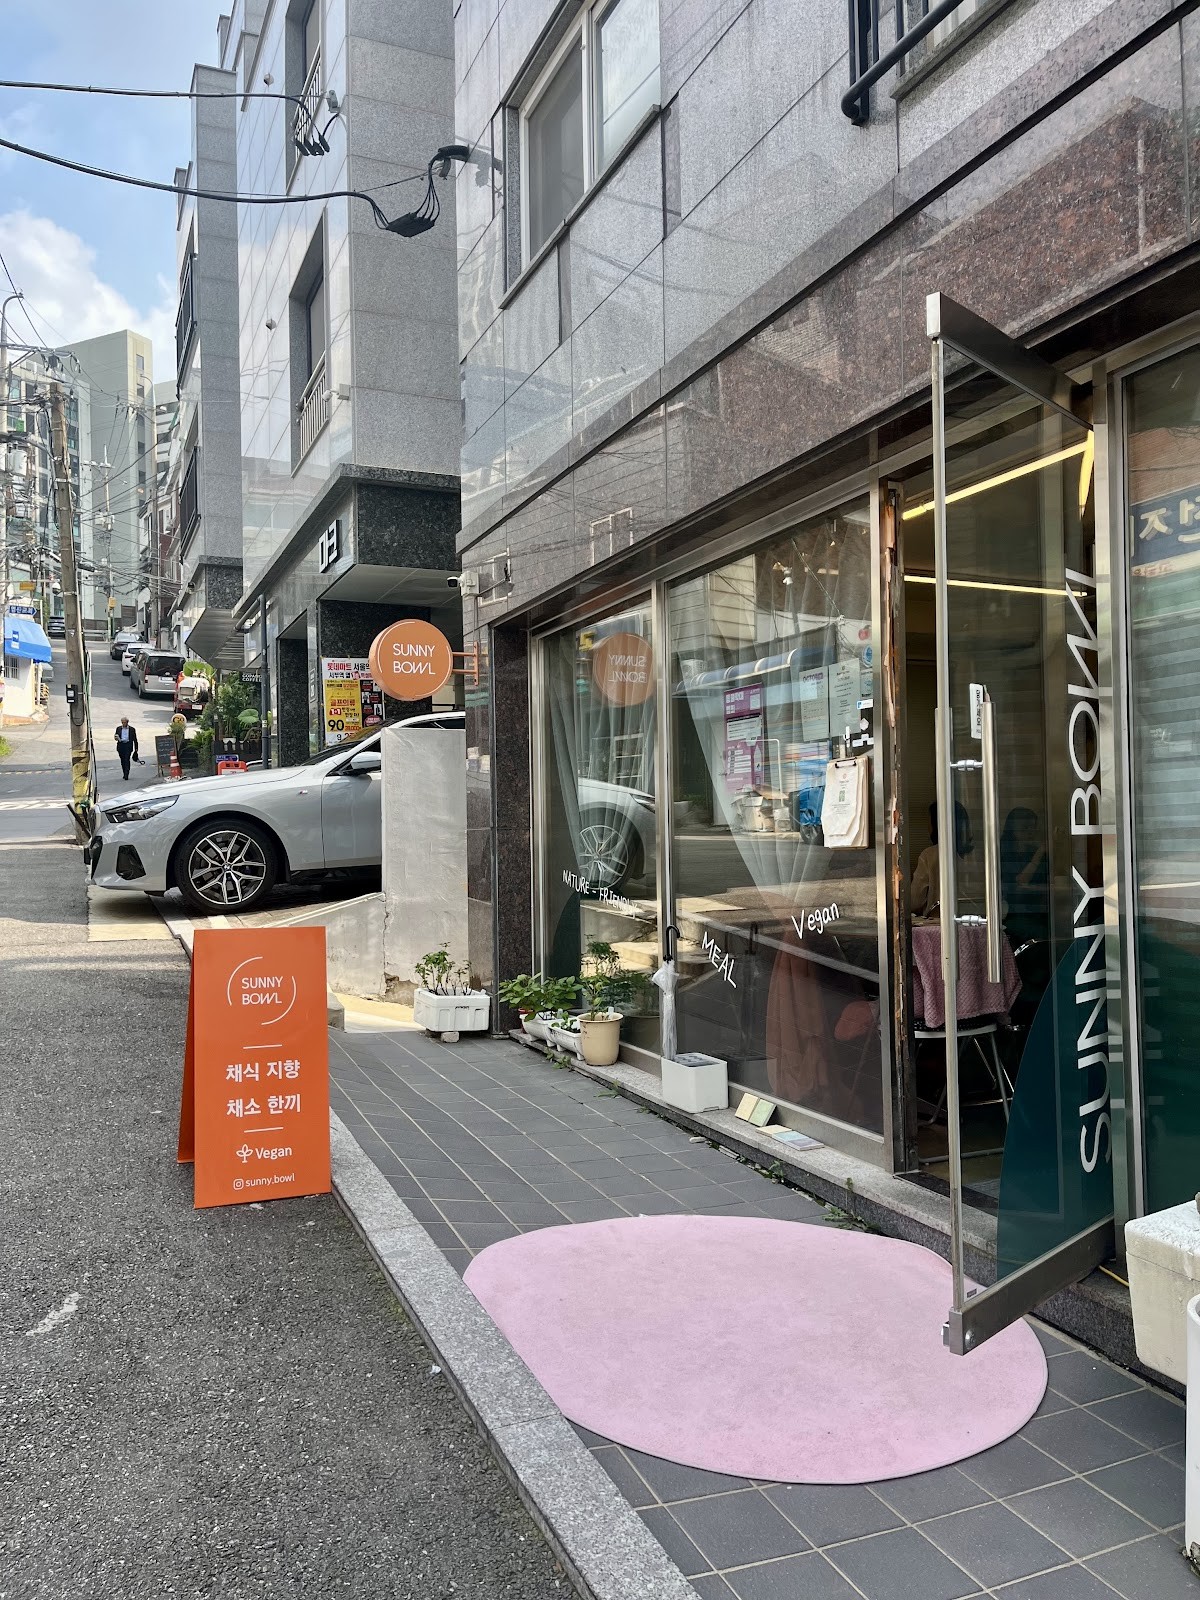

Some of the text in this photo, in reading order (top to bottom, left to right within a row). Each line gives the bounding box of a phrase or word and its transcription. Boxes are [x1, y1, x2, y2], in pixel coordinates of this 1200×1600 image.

[393, 643, 435, 657] SUNNY
[327, 662, 352, 671] 롯데마트
[393, 661, 436, 675] BOWL
[328, 719, 345, 731] 90
[562, 869, 590, 895] NATURE
[791, 902, 840, 939] Vegan
[701, 931, 737, 988] MEAL
[241, 976, 283, 989] SUNNY
[241, 993, 282, 1005] BOWL
[1071, 865, 1112, 1173] SUNNY
[225, 1059, 300, 1083] 채식 지향
[226, 1093, 301, 1118] 채소 한끼
[255, 1145, 292, 1160] Vegan
[245, 1172, 295, 1188] sunny.bowl
